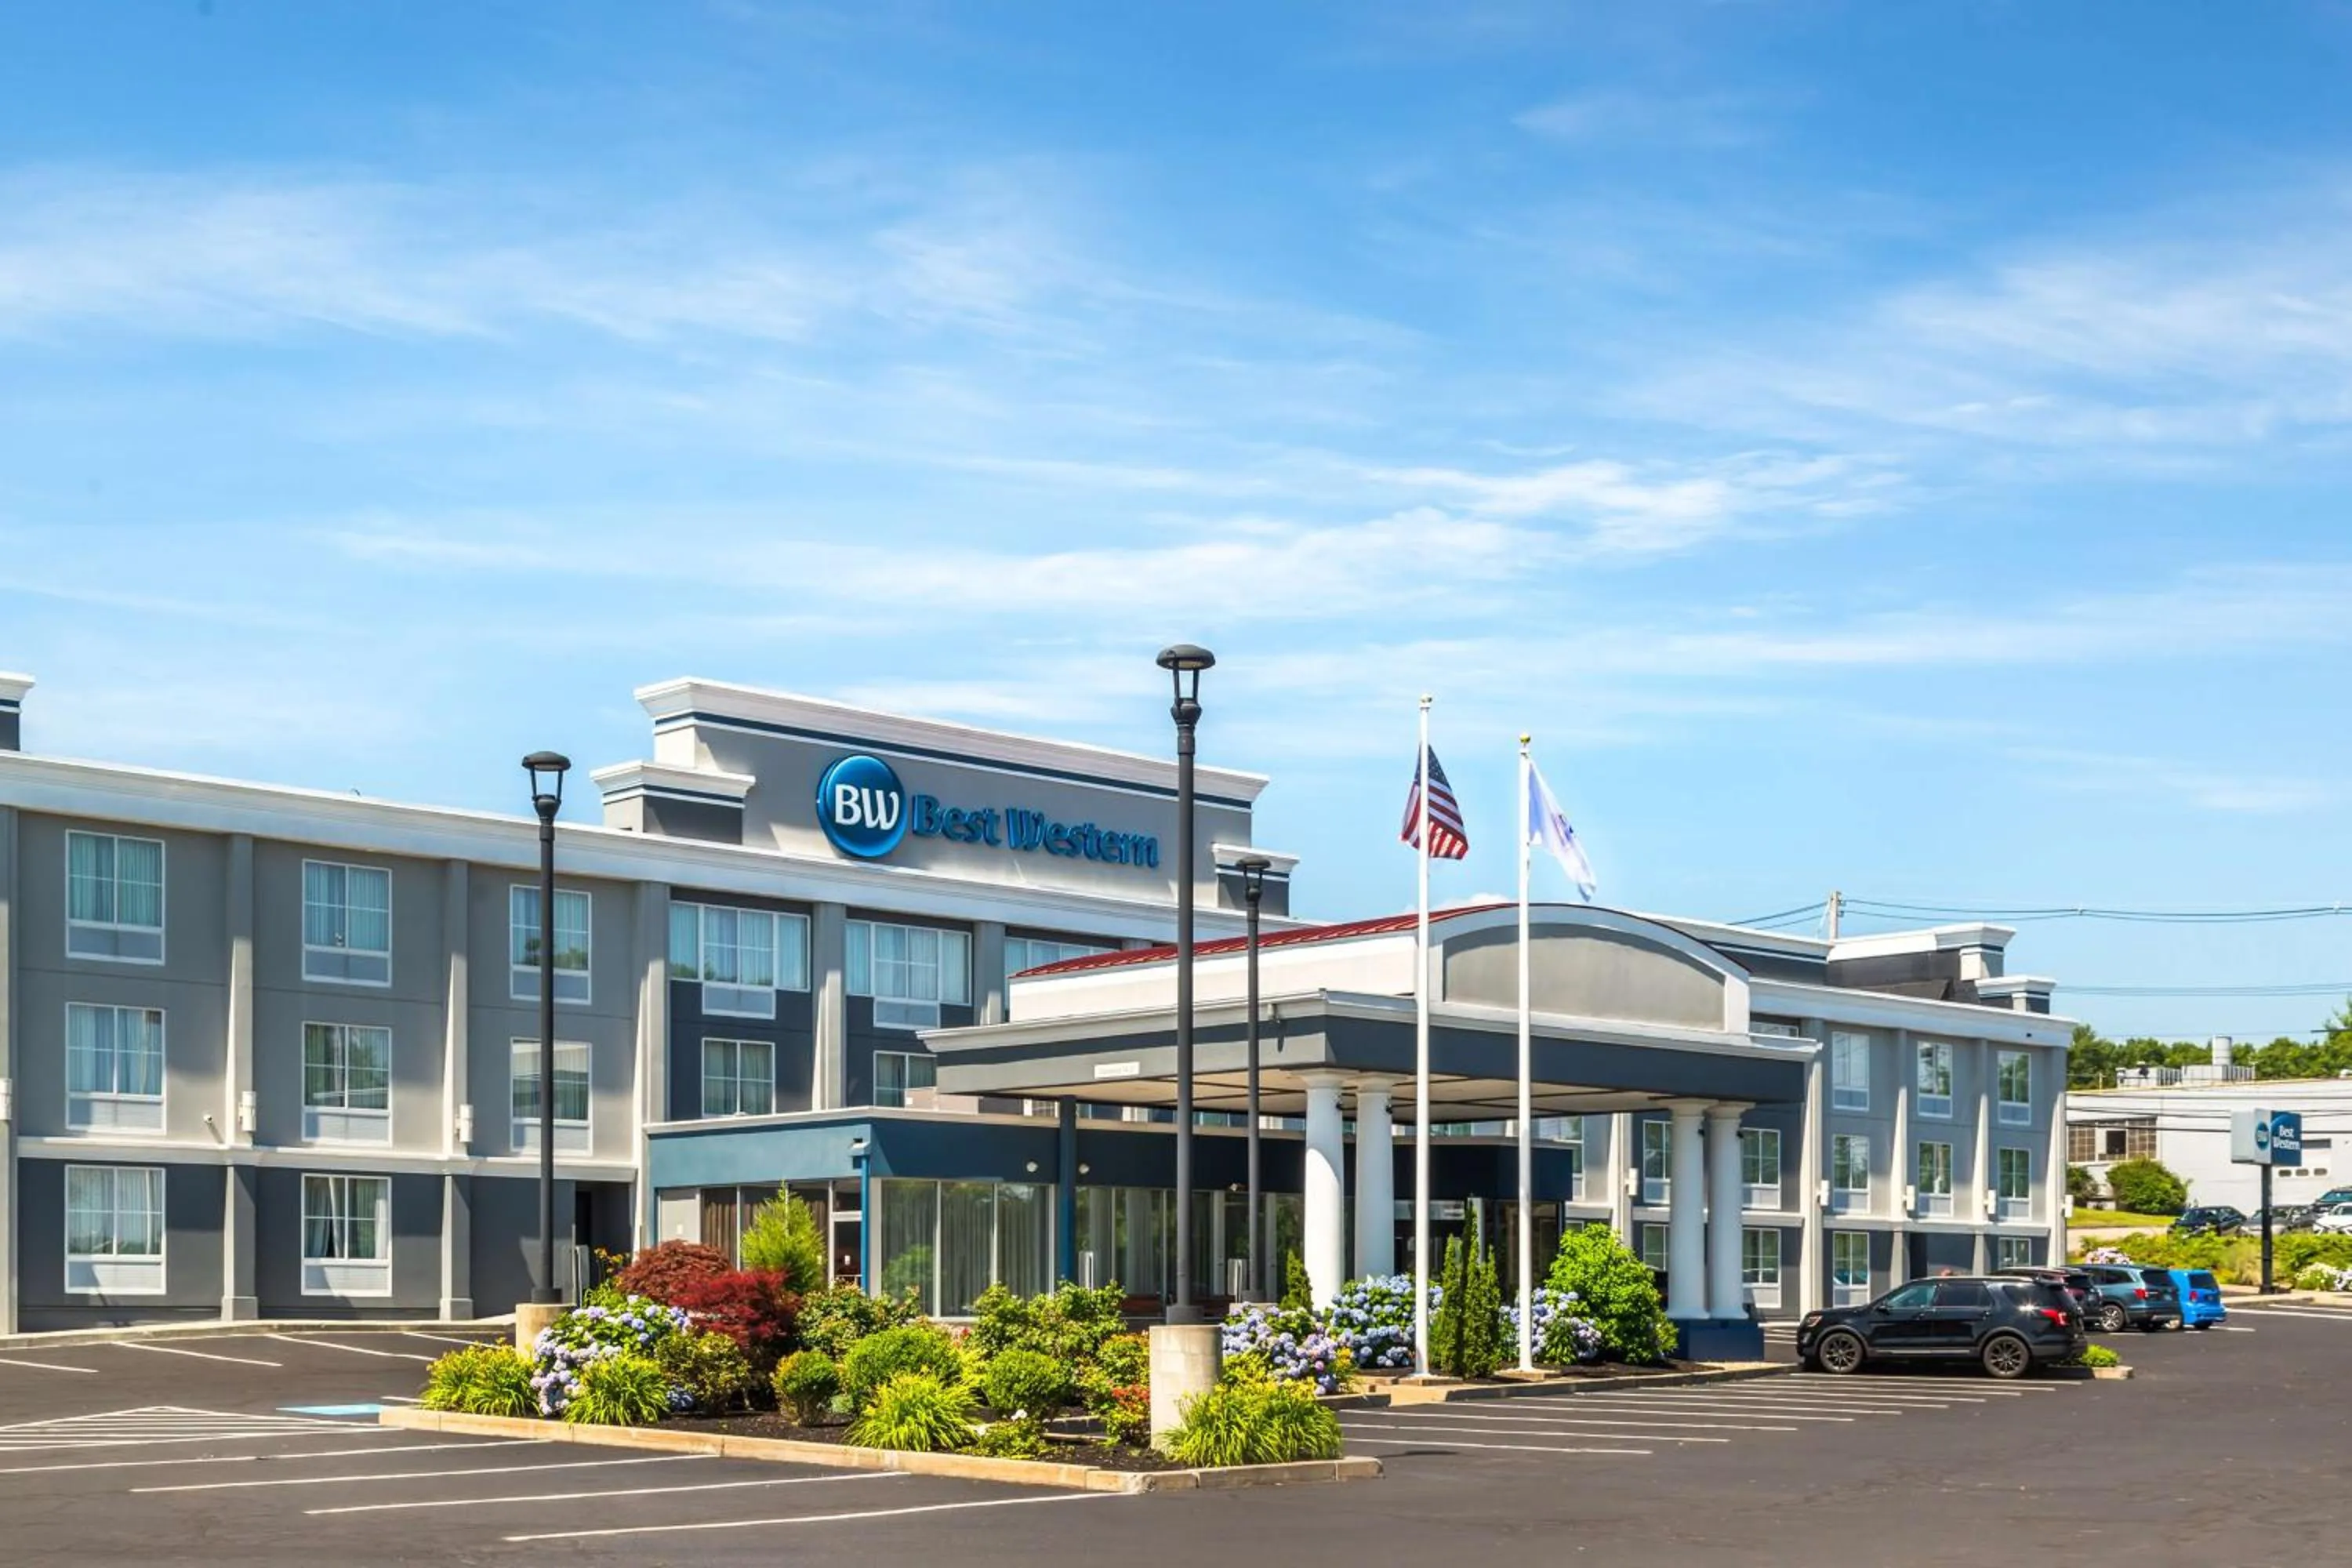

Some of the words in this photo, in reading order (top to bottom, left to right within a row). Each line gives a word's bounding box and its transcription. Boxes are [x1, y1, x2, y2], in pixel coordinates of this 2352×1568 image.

[834, 784, 899, 830] BW
[912, 793, 1002, 846] Best
[1005, 808, 1159, 868] Western
